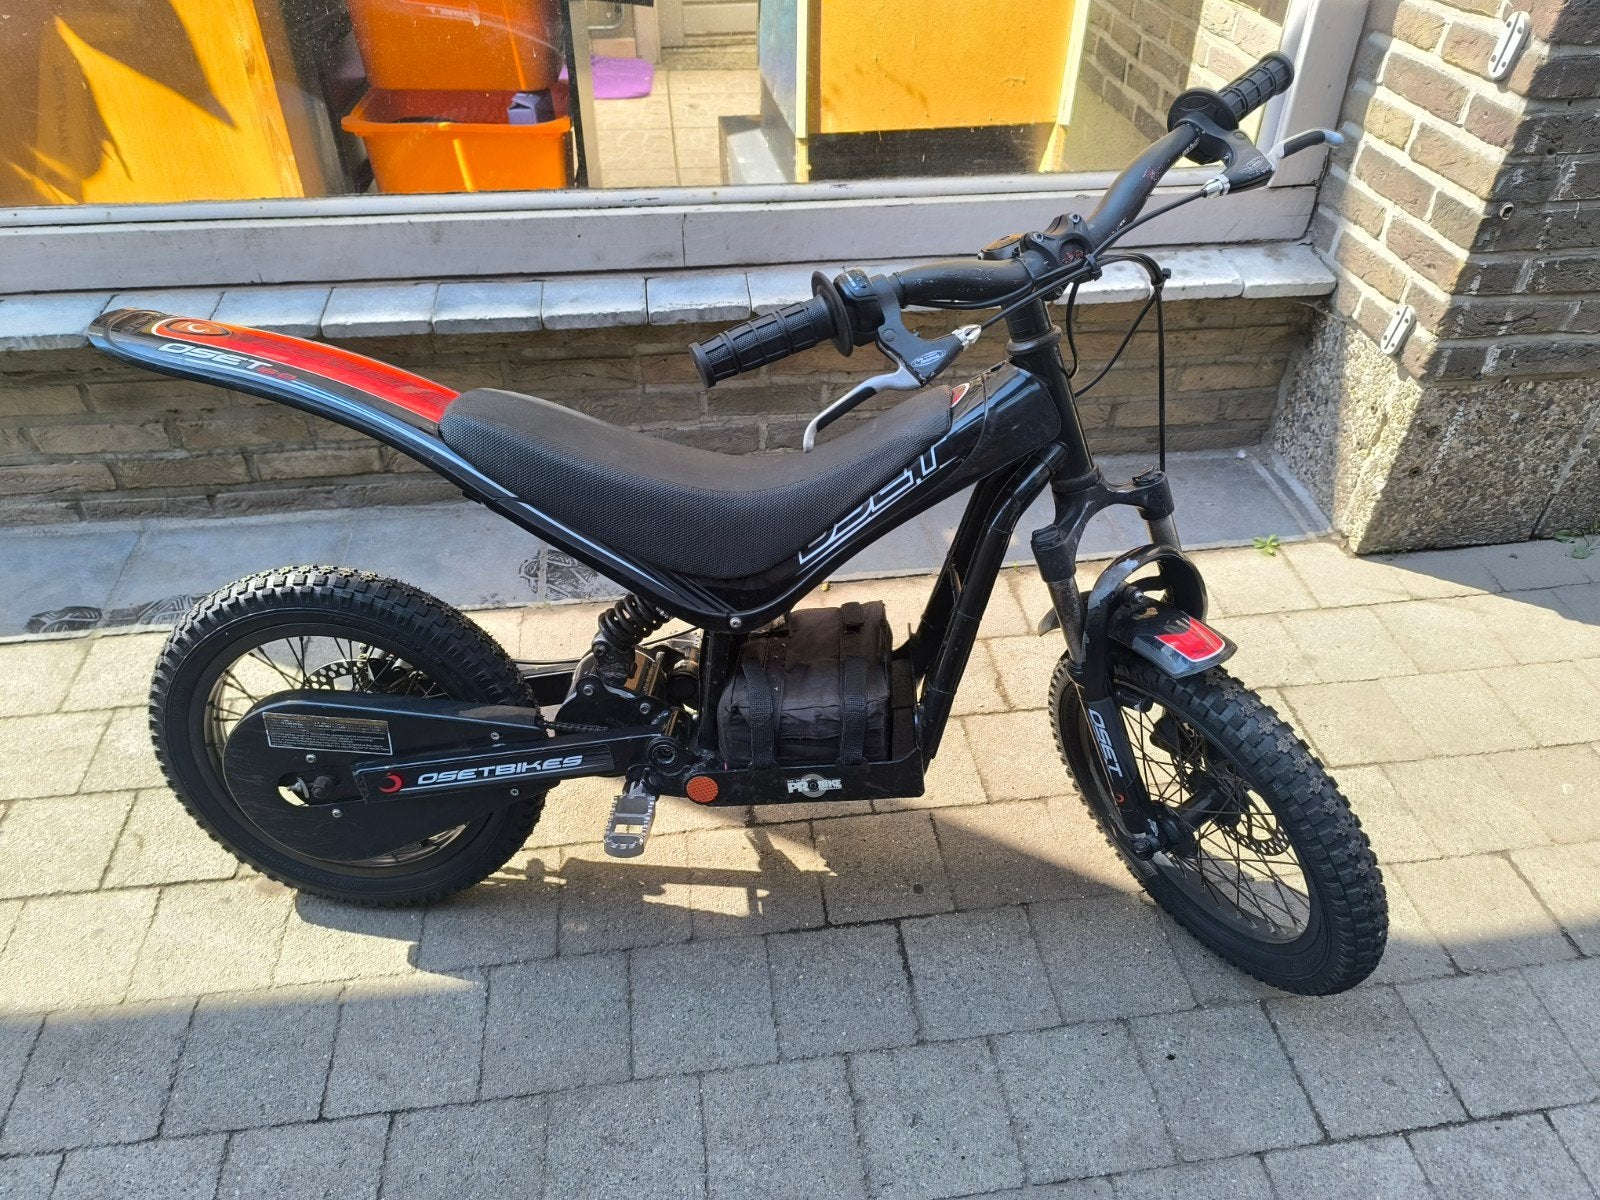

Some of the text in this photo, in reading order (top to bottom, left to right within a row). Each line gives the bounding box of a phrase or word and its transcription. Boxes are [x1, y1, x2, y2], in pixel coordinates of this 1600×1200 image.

[157, 343, 273, 370] OSET
[1088, 708, 1123, 778] OSET
[417, 755, 584, 785] OSETBIKES
